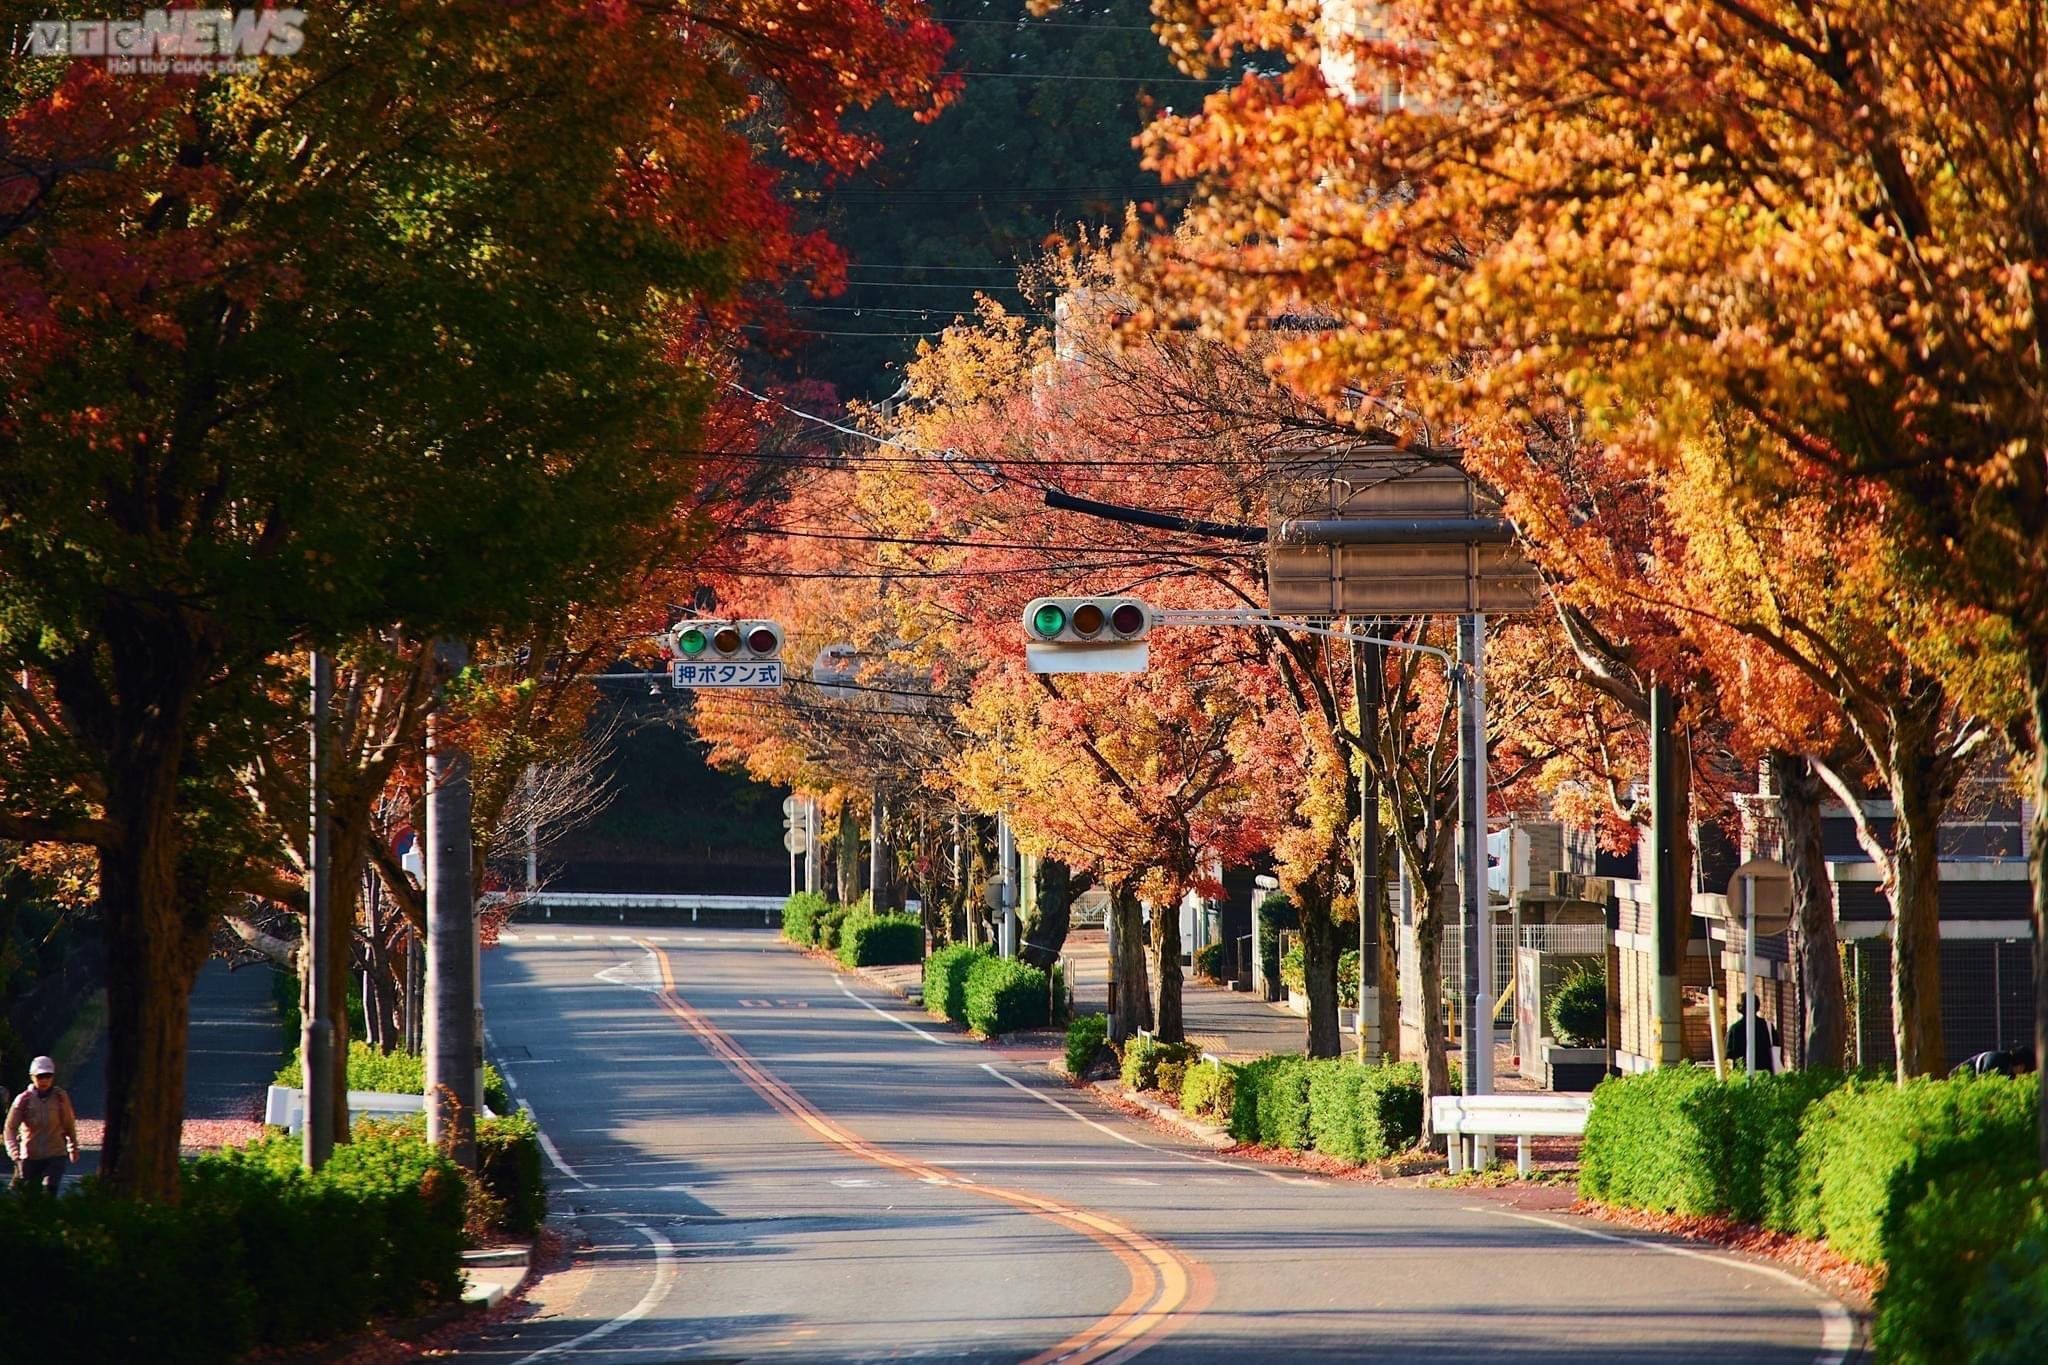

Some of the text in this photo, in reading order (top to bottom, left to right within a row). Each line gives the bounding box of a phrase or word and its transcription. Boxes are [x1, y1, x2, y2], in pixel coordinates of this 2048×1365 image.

[677, 665, 777, 684] 押ボタン式
